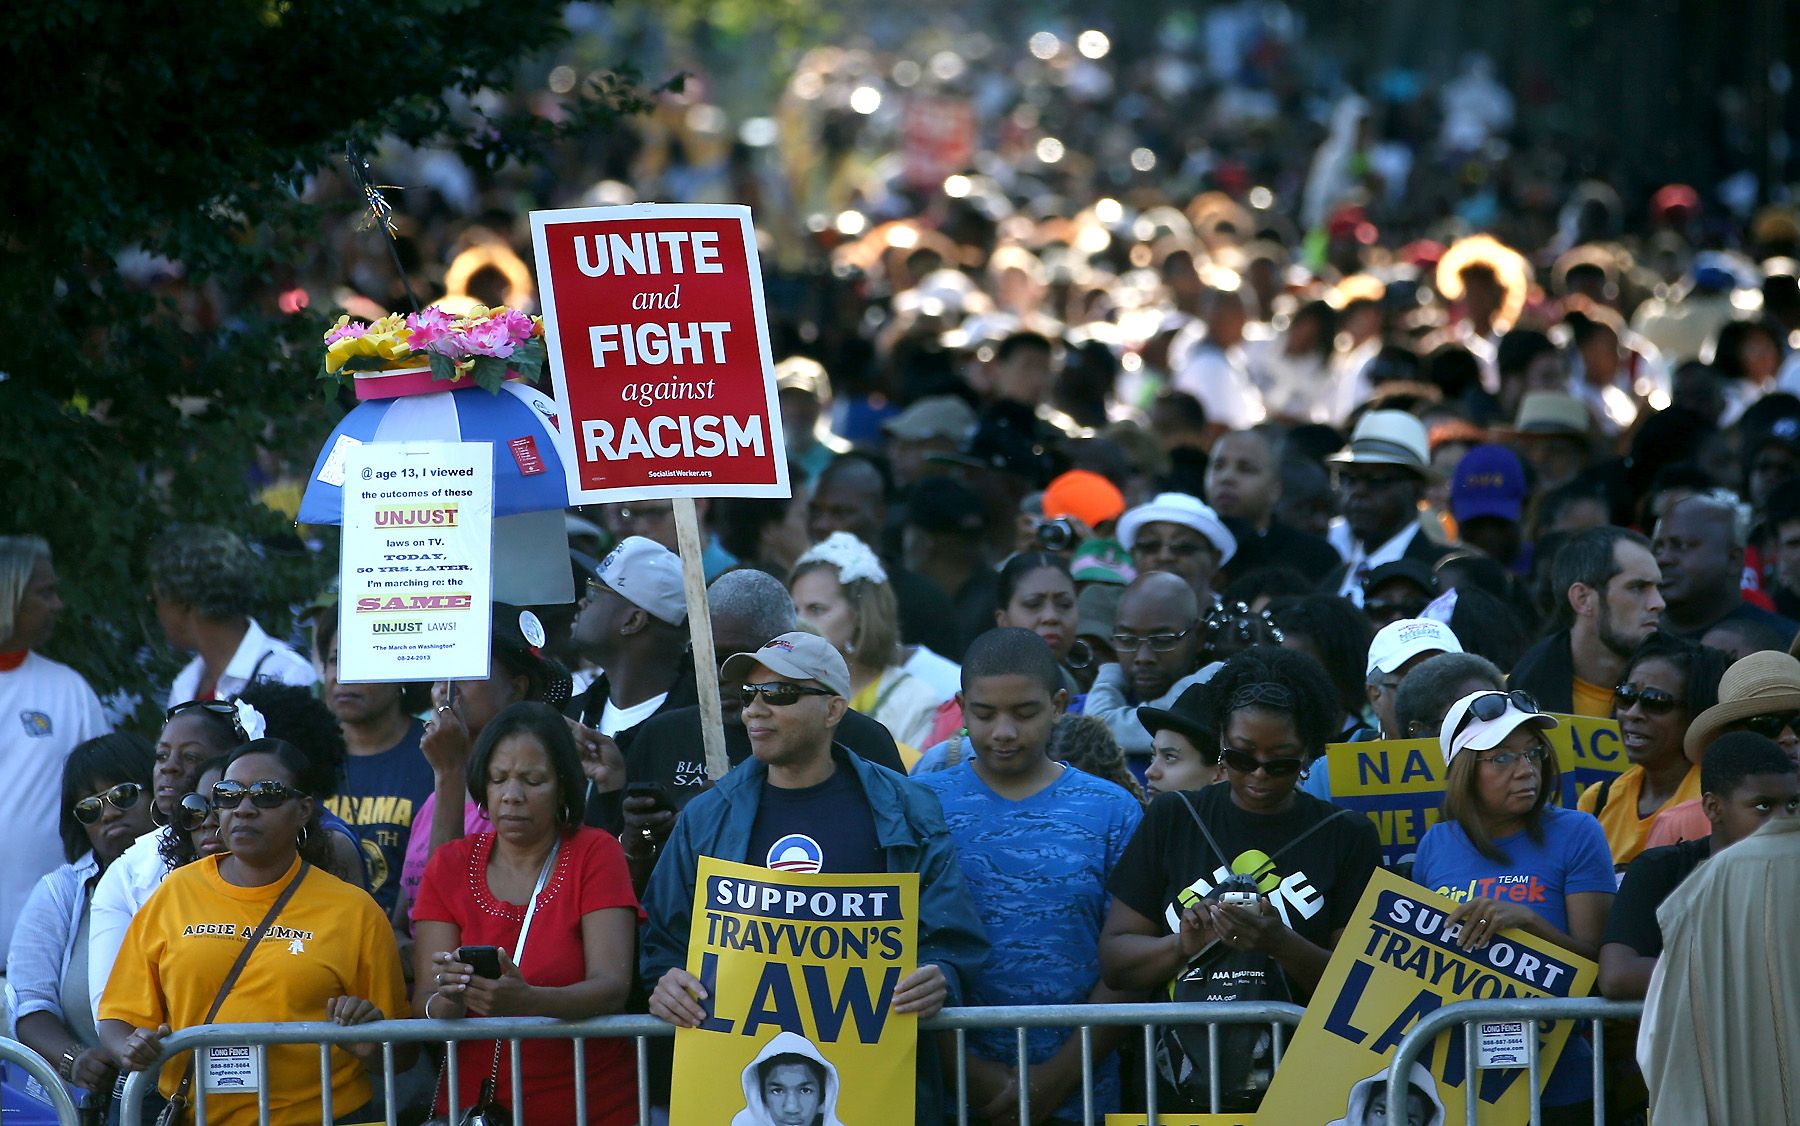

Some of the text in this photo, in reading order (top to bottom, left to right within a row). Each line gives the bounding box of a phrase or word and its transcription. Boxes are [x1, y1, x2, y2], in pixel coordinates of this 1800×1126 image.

[573, 231, 724, 277] UNITE
[631, 284, 681, 310] and
[588, 321, 732, 368] FIGHT
[621, 375, 716, 407] against
[581, 414, 766, 463] RACISM
[361, 466, 474, 480] @ age 13, I viewed
[648, 469, 713, 478] SocialistWorker.org
[361, 491, 378, 499] the
[431, 488, 442, 497] of
[444, 488, 473, 496] these
[375, 509, 459, 526] UNJUST
[386, 539, 410, 547] laws
[427, 538, 445, 546] TV.
[383, 553, 447, 561] TODAY,
[415, 564, 473, 572] LATER,
[367, 579, 382, 588] I'm
[384, 579, 430, 588] marching
[447, 578, 464, 586] the
[356, 595, 472, 611] SAME
[372, 621, 457, 633] UNJUST LAWS!
[1358, 749, 1445, 785] NA
[1498, 875, 1529, 884] TEAM
[716, 879, 889, 917] SUPPORT
[183, 924, 235, 937] AGGIE
[705, 912, 904, 961] TRAYVON'S
[1388, 899, 1565, 989] SUPORT
[1211, 971, 1230, 980] AAA
[1363, 923, 1553, 1030] TRAYVO
[696, 951, 902, 1044] LAW
[1483, 1024, 1521, 1033] LONG FENCE
[211, 1047, 249, 1056] LONG FENCE
